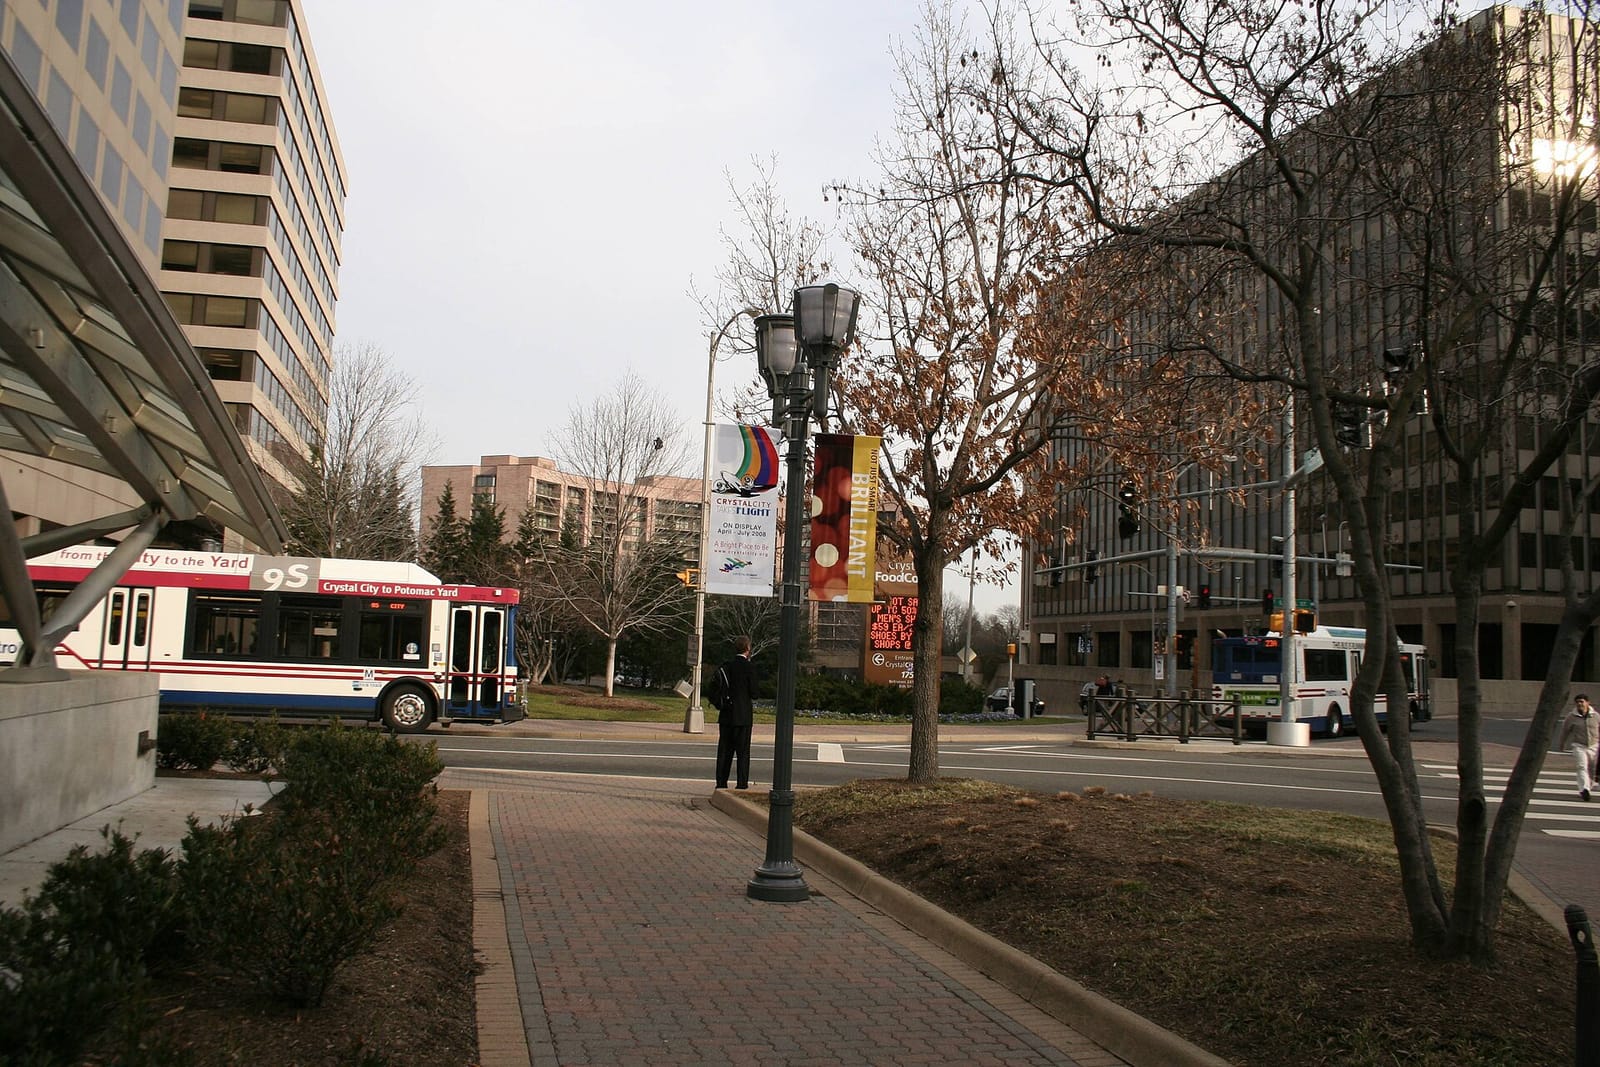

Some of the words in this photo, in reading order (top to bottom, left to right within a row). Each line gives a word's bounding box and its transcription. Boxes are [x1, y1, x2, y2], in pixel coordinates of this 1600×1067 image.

[869, 466, 877, 485] JUST
[868, 487, 877, 512] SMART
[736, 507, 770, 516] FLIGHT
[848, 473, 870, 579] BRILLIANT
[720, 541, 737, 550] Bright
[60, 550, 92, 560] from
[164, 556, 178, 565] to
[182, 556, 205, 567] the
[211, 556, 249, 569] Yard
[888, 561, 915, 572] Cryst
[263, 563, 309, 591] 9S
[875, 572, 918, 583] FoodCo
[323, 582, 358, 594] Crystal
[360, 583, 379, 596] City
[382, 585, 392, 594] to
[394, 586, 435, 596] Potomac
[437, 588, 459, 597] Yard
[907, 597, 918, 606] SA
[871, 604, 882, 613] UP
[871, 622, 889, 631] $59
[870, 631, 897, 640] SHOES
[900, 632, 913, 641] BY
[874, 639, 901, 649] SHOPS
[365, 669, 374, 677] M
